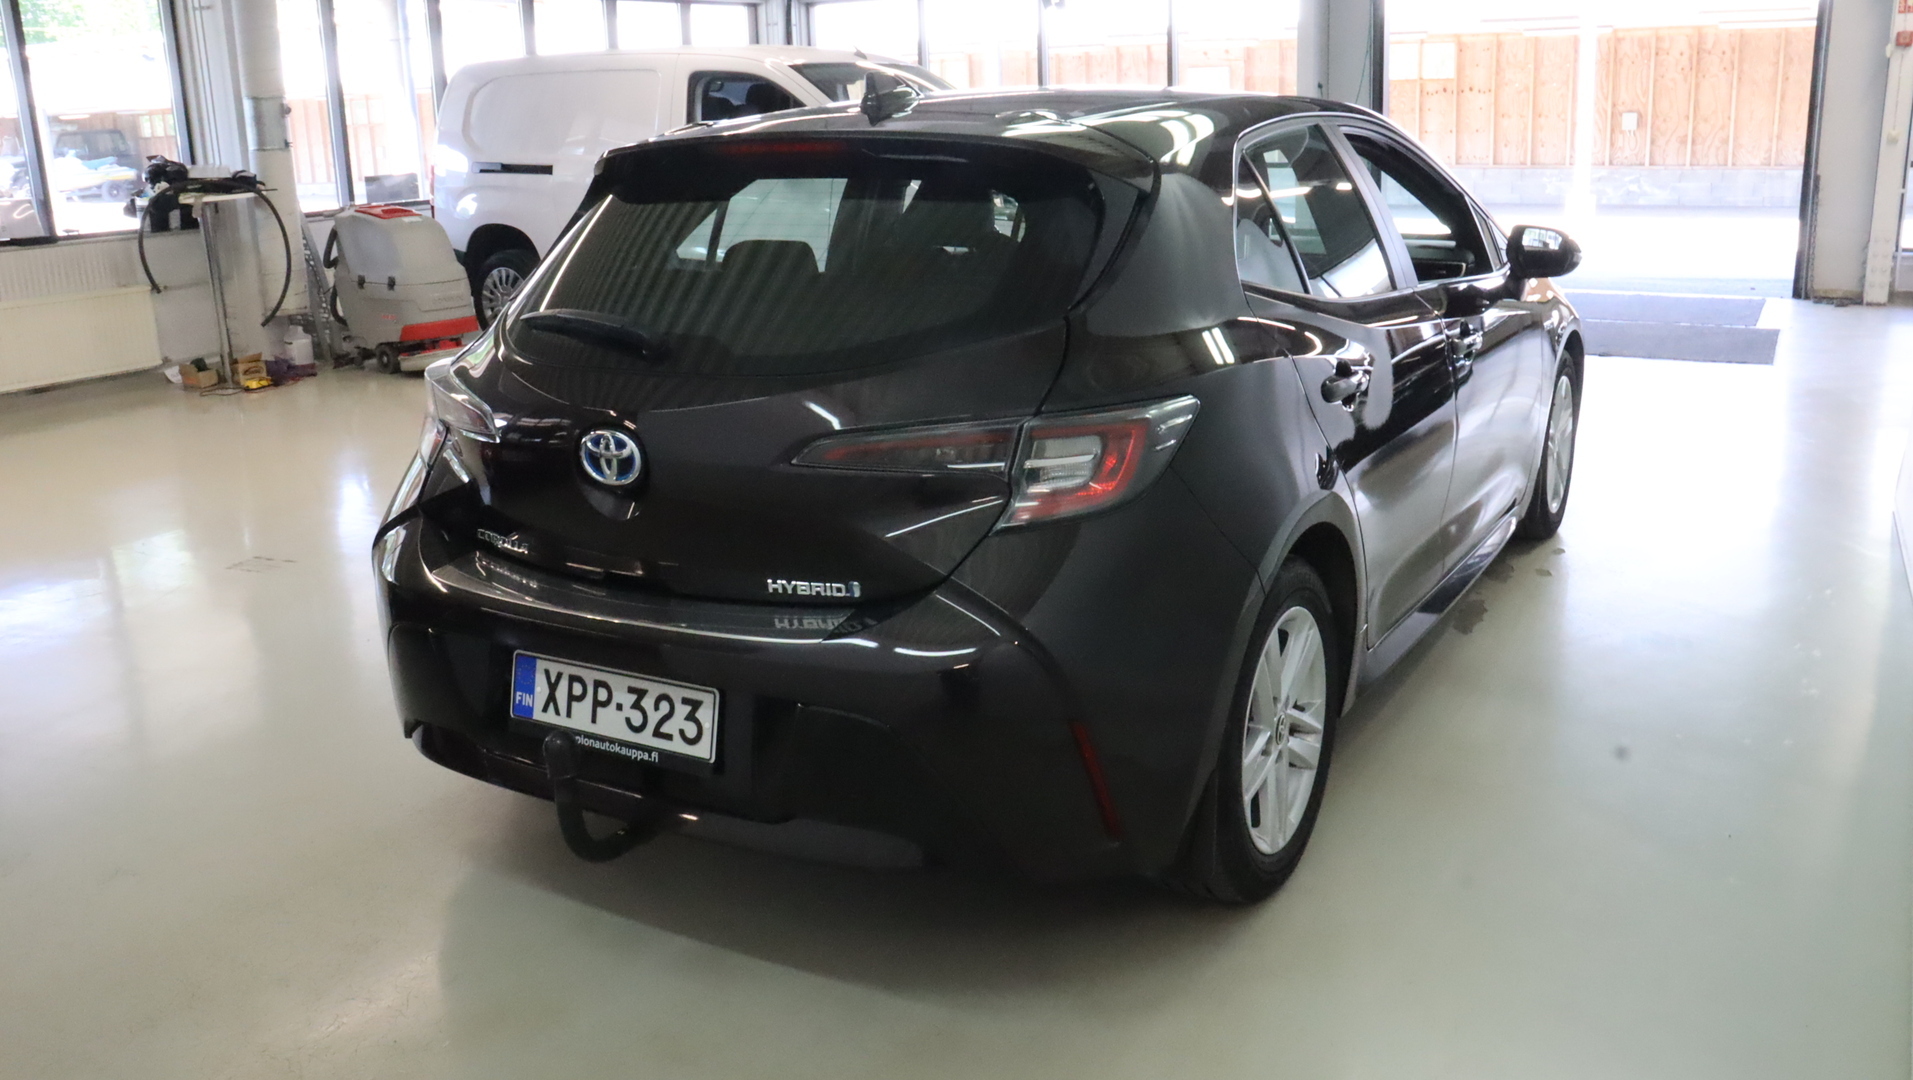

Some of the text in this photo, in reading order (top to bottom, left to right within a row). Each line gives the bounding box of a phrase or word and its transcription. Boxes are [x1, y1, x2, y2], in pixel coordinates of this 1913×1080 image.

[767, 579, 846, 597] HYBRID
[515, 691, 534, 708] FIN
[541, 668, 704, 746] XPP-323
